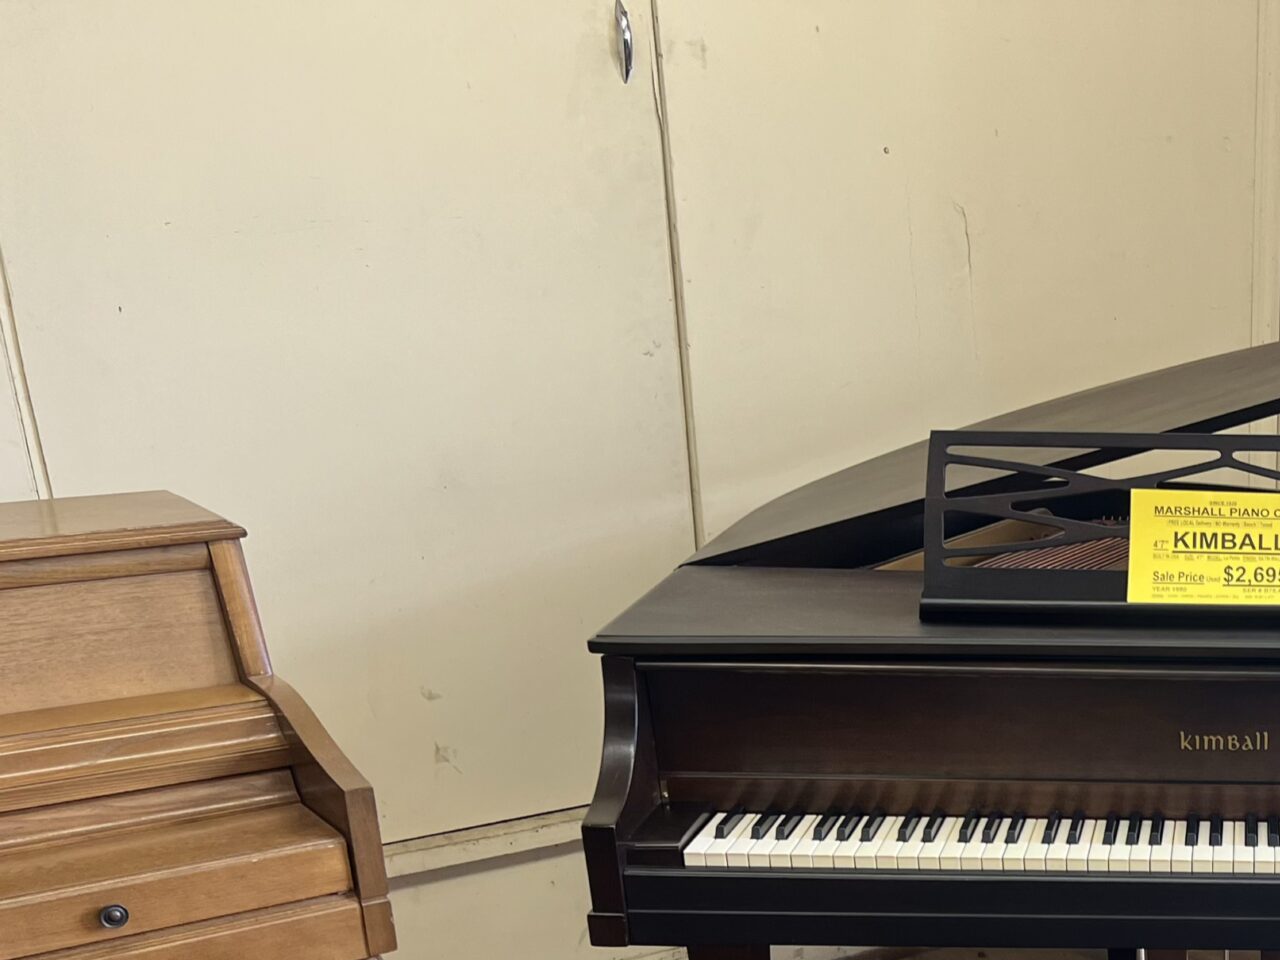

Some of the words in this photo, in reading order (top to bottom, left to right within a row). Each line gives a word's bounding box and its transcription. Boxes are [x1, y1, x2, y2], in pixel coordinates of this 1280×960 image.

[1154, 505, 1227, 517] MARSHALL
[1229, 507, 1271, 518] PIANO
[1152, 571, 1175, 582] Sale
[1178, 572, 1205, 583] Price
